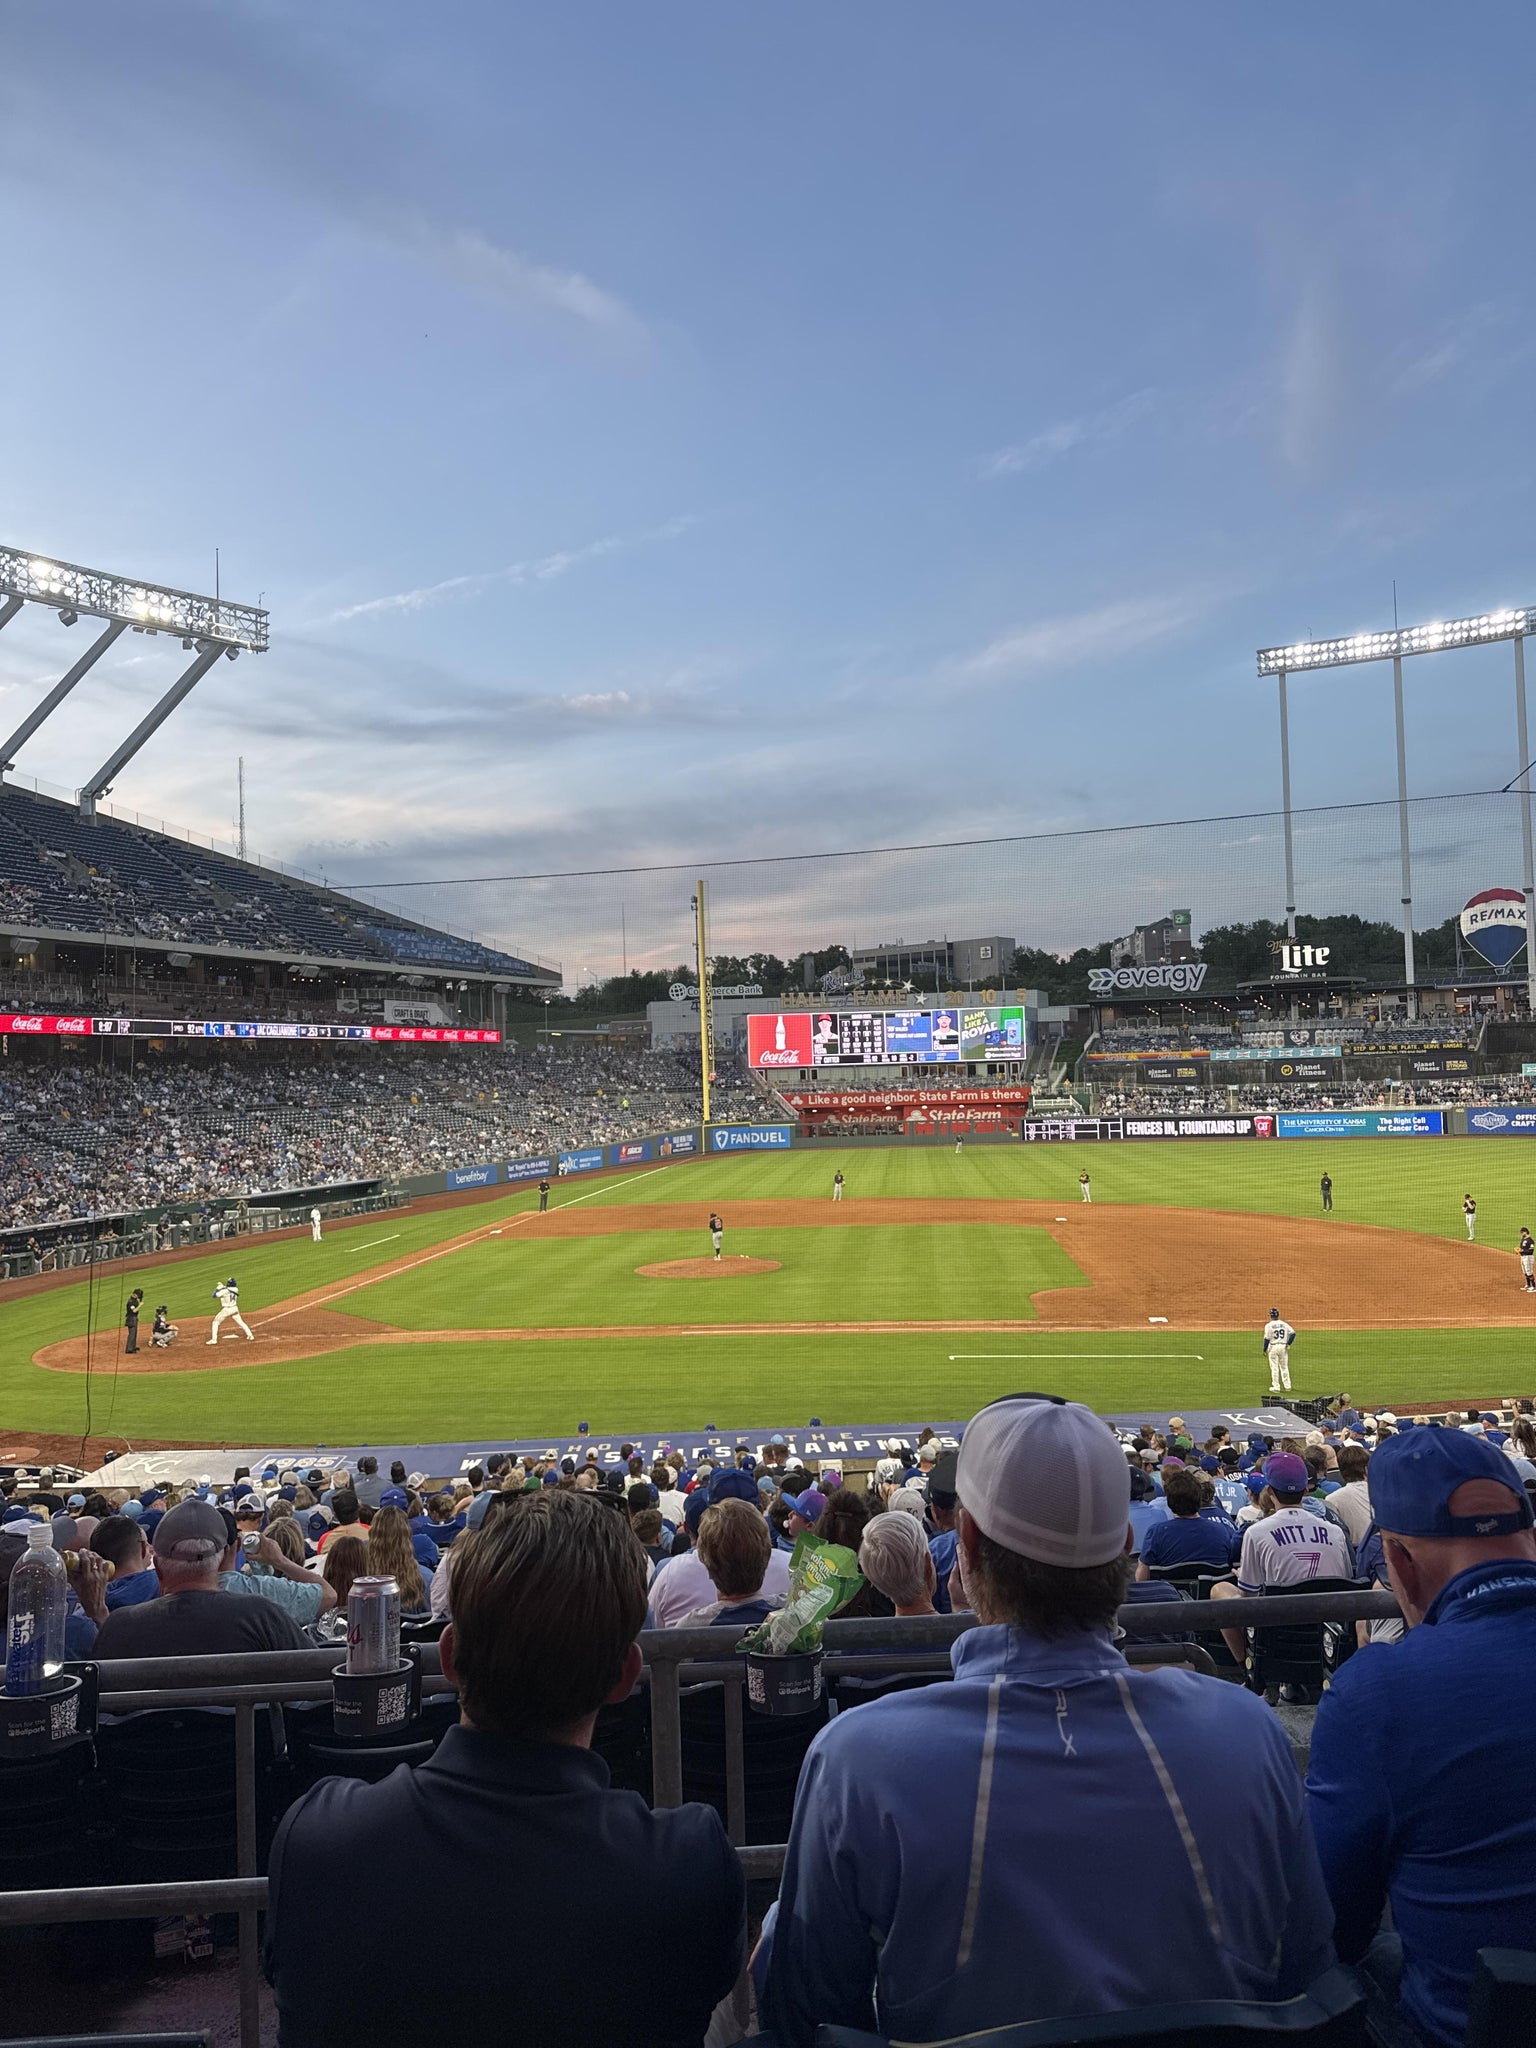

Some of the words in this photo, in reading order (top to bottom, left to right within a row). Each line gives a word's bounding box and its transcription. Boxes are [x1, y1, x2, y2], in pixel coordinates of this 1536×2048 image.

[1470, 908, 1526, 924] RE/MAX
[1266, 936, 1298, 954] Miller
[1280, 944, 1330, 974] Lite
[1116, 963, 1206, 990] evergy
[738, 986, 761, 994] Bank
[780, 992, 832, 1008] HALL
[853, 988, 907, 1006] FAME
[945, 990, 964, 1006] 20
[980, 989, 996, 1004] 10
[1016, 988, 1027, 1004] 5
[394, 1008, 408, 1018] CRAFT
[414, 1010, 428, 1018] DRAFT
[964, 1010, 986, 1022] BANK
[962, 1022, 998, 1040] ROYAL
[965, 1020, 981, 1029] LIKE
[760, 1050, 800, 1064] Coca-Cola
[808, 1096, 830, 1104] Like
[841, 1094, 866, 1106] good
[869, 1093, 917, 1105] neighbor,
[920, 1092, 947, 1101] State
[950, 1091, 978, 1100] Farm
[980, 1090, 989, 1099] is
[992, 1090, 1024, 1099] there.
[1127, 1121, 1163, 1135] FENCES
[1164, 1121, 1178, 1136] IN,
[1179, 1120, 1235, 1134] FOUNTAINS
[1236, 1120, 1251, 1134] UP
[730, 1132, 786, 1144] FANDUEL
[456, 1170, 488, 1184] benefitbay
[1274, 1329, 1285, 1339] 39
[708, 1436, 750, 1446] OF
[785, 1432, 854, 1443] THE
[264, 1456, 338, 1469] 1985
[1270, 1525, 1306, 1546] WITT
[1310, 1526, 1333, 1546] JR.
[1293, 1552, 1321, 1577] 7
[1054, 1688, 1077, 1756] RLX
